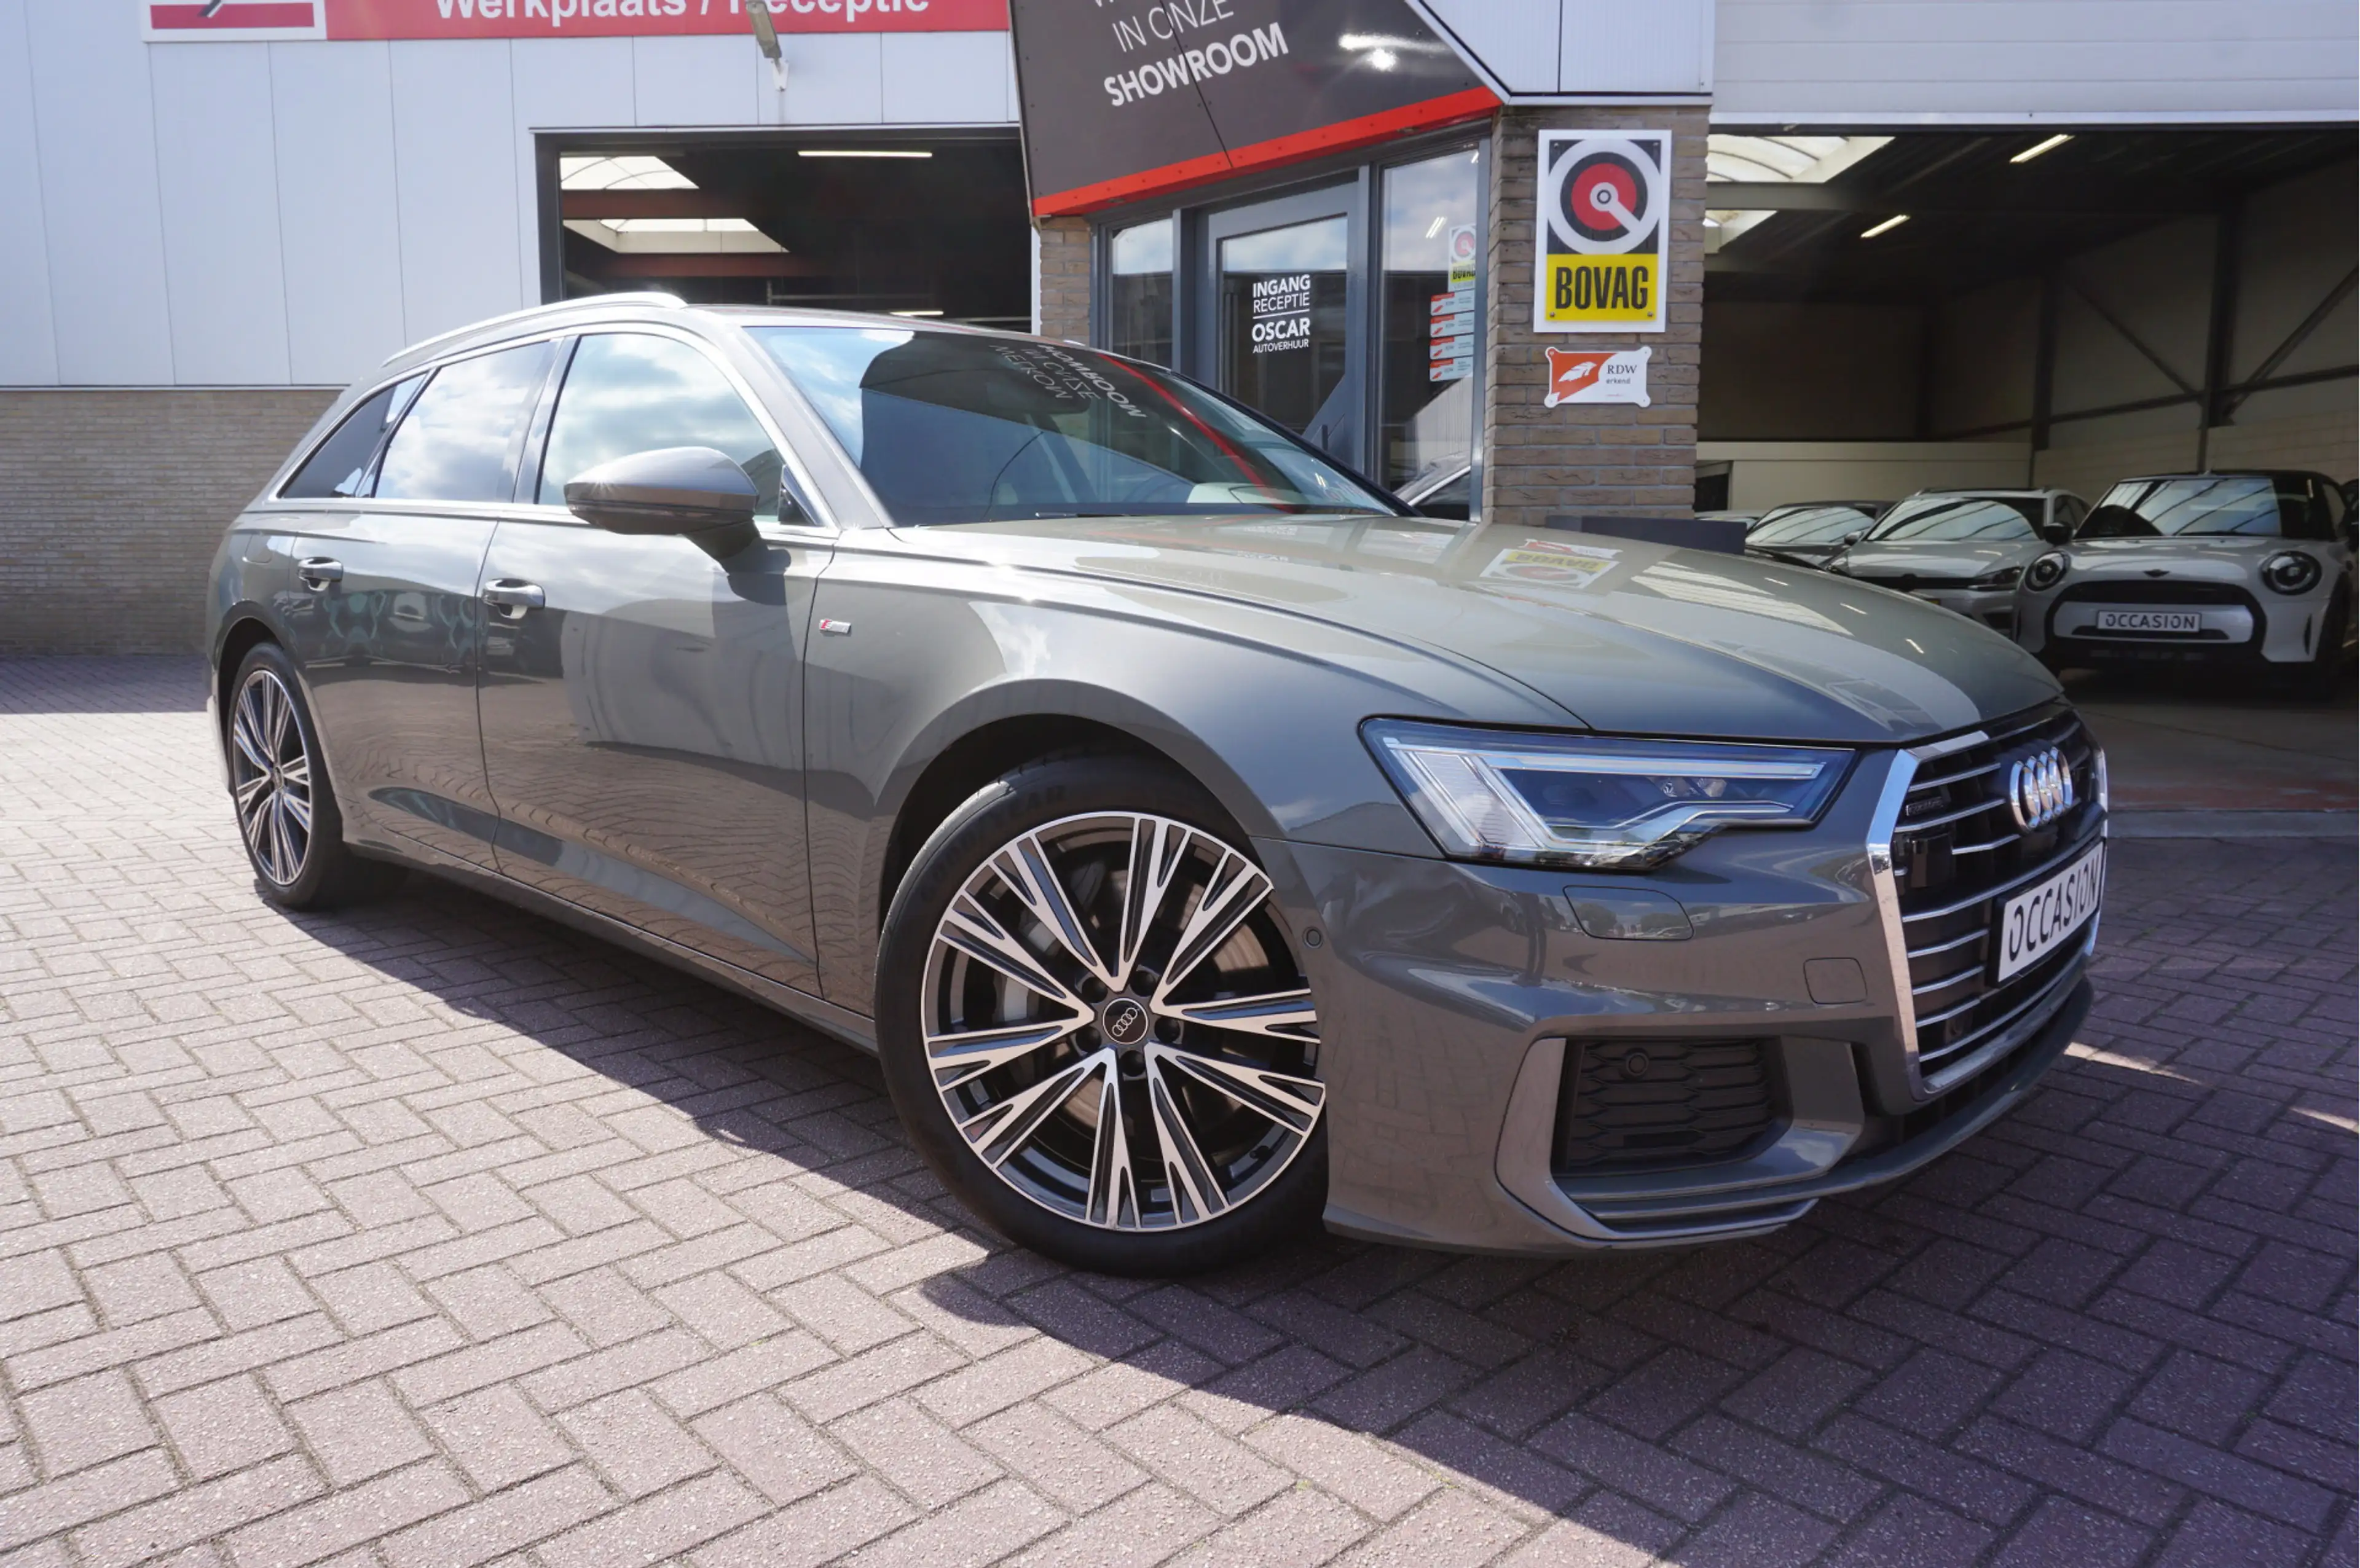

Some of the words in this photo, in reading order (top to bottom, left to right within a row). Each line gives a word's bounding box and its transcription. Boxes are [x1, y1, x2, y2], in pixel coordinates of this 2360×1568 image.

[1112, 15, 1147, 53] IN
[1148, 0, 1234, 39] ONZE
[1104, 22, 1289, 106] SHOWROOM
[1253, 274, 1311, 298] INGANG
[1555, 266, 1649, 310] BOVAG
[1253, 292, 1310, 313] RECEPTIE
[1251, 317, 1311, 342] OSCAR
[1253, 339, 1310, 354] AUTOVERHUUR
[1607, 364, 1637, 374] RDW
[2105, 614, 2195, 629] OCCASION
[2008, 853, 2099, 962] OCCASION
